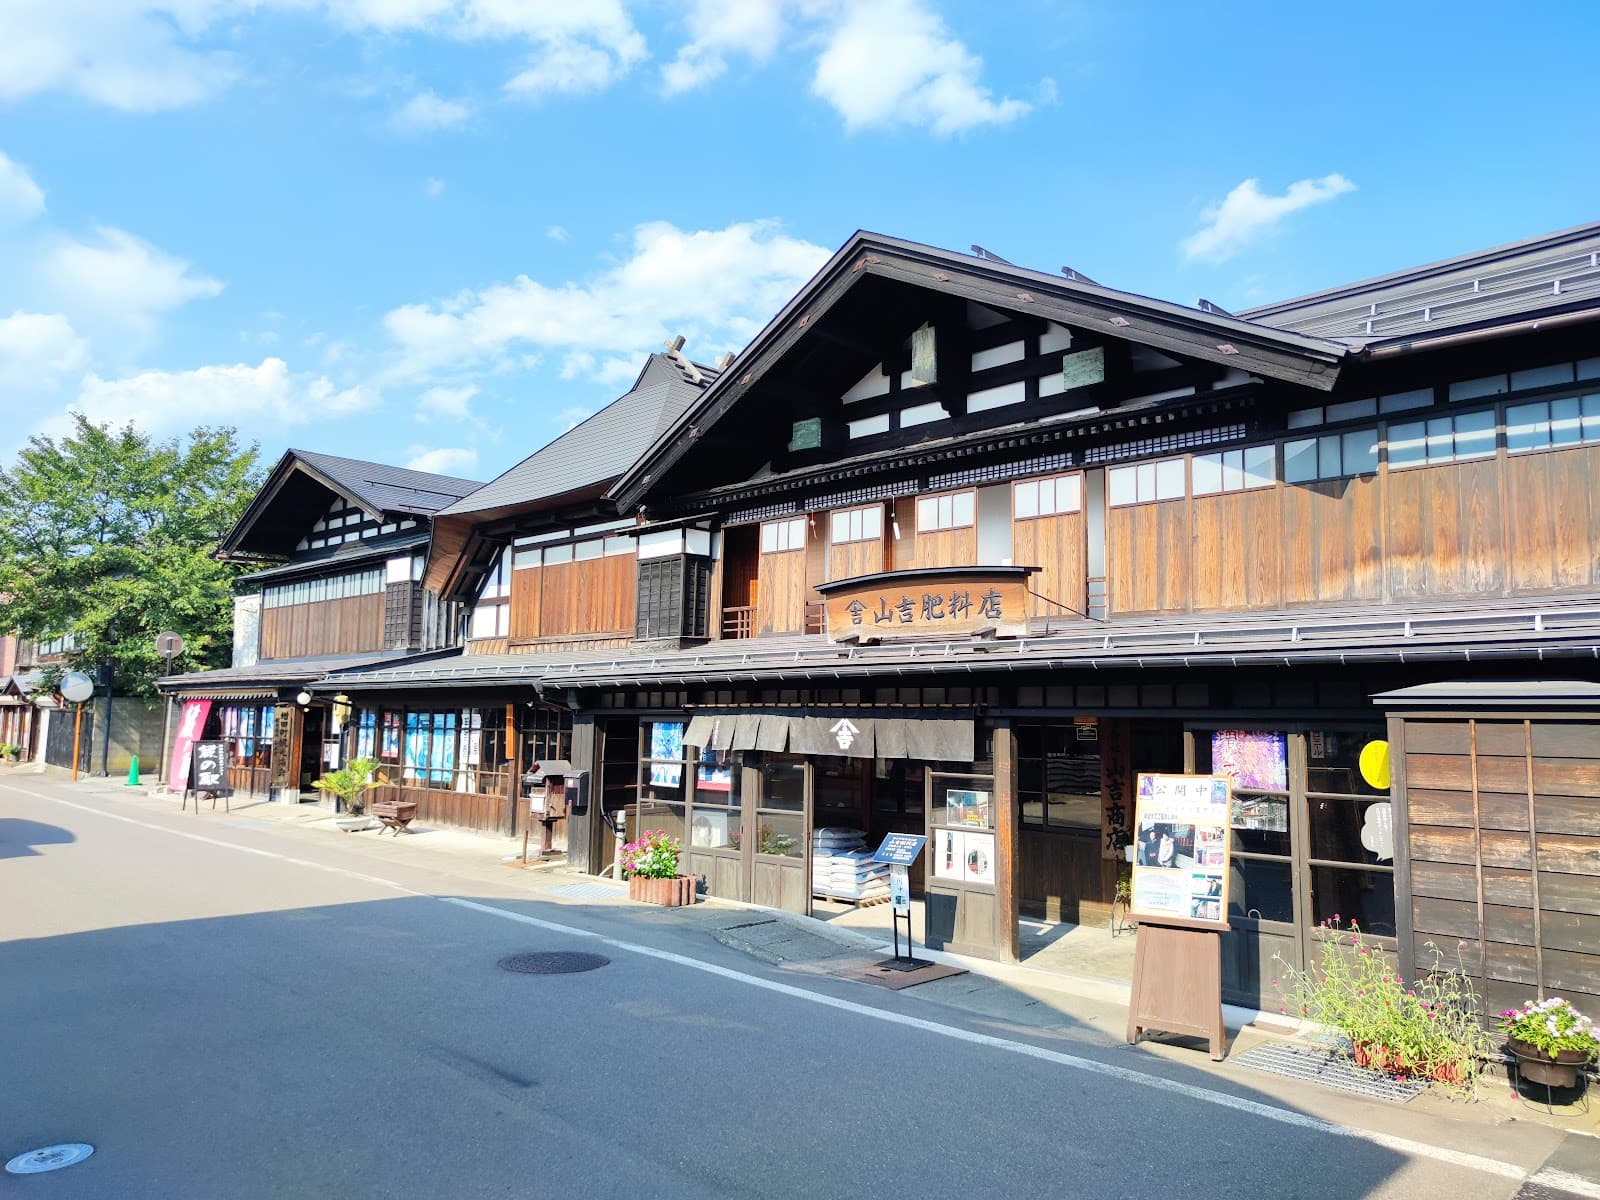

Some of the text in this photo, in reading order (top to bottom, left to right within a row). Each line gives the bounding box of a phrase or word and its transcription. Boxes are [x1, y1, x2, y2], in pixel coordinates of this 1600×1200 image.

[873, 587, 1003, 624] 山吉肥料店
[198, 743, 220, 786] 蔵の駅
[1155, 783, 1208, 798] 公開中
